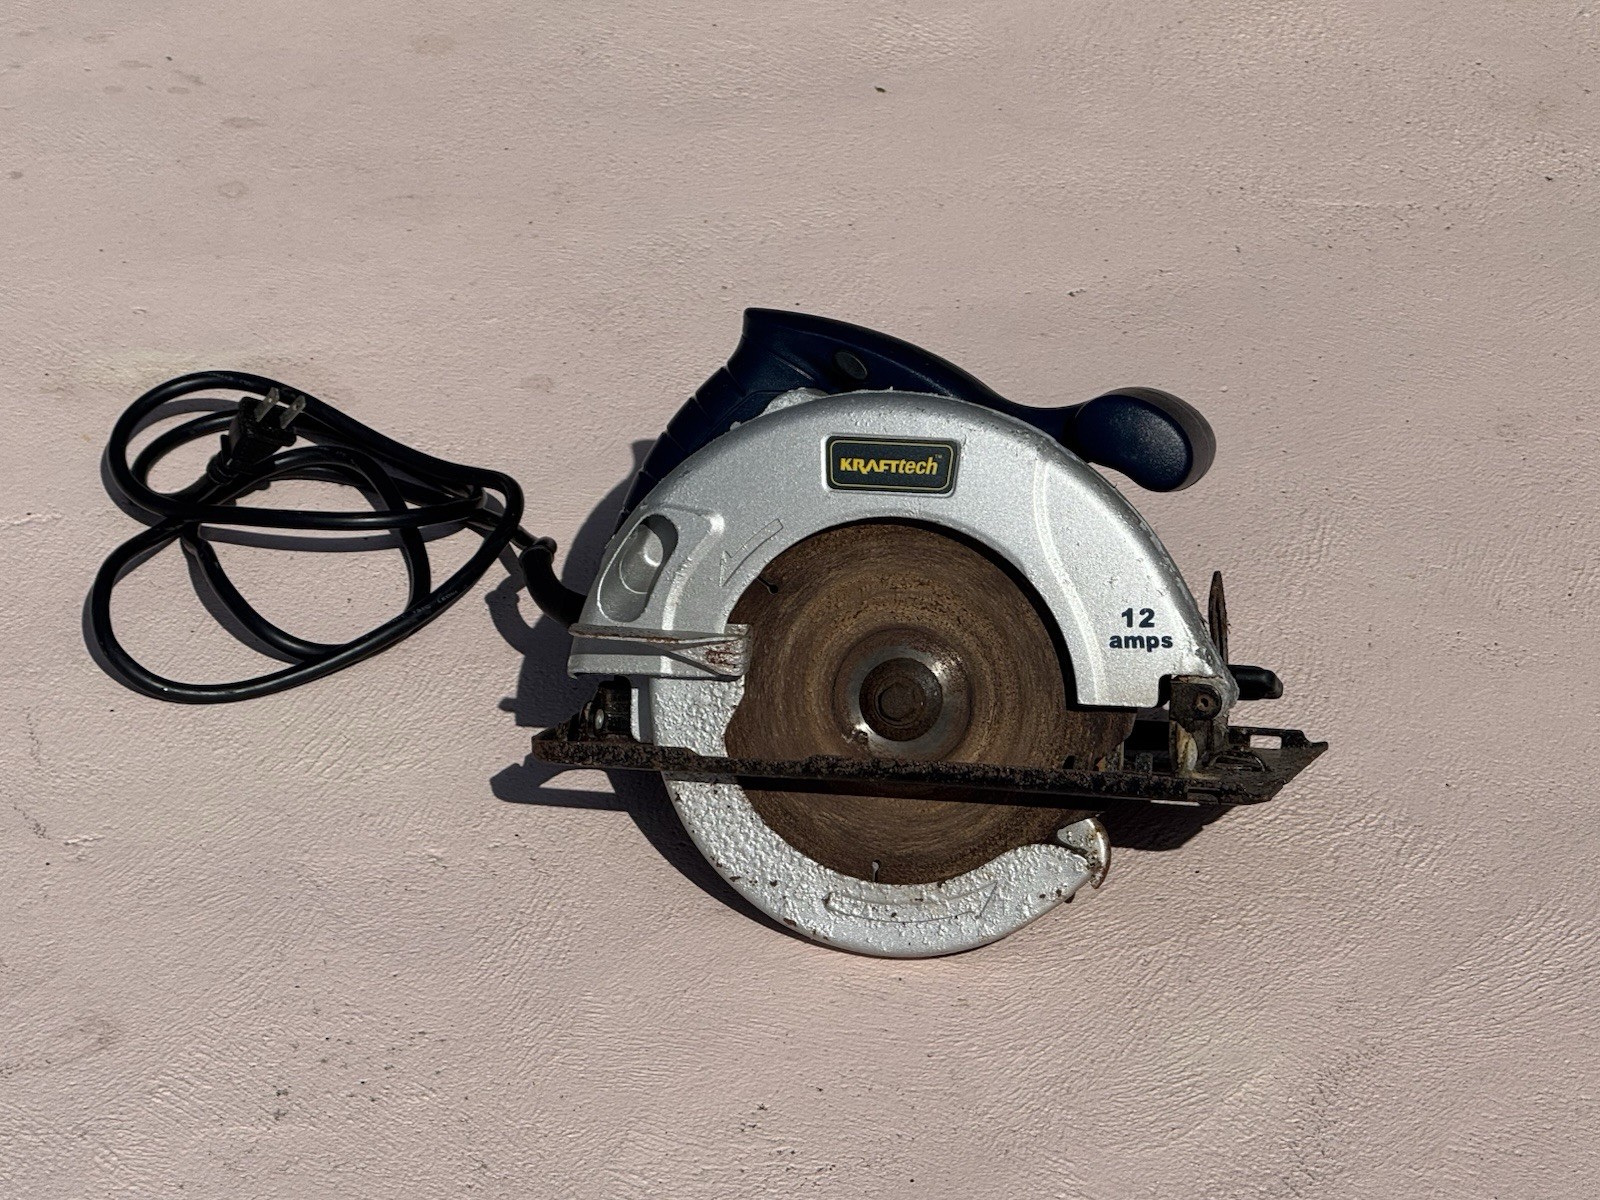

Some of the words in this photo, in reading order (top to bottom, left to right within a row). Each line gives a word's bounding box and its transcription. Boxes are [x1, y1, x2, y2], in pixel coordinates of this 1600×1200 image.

[840, 457, 938, 475] KRAFTtech
[1121, 608, 1155, 628] 12
[1109, 635, 1173, 653] amps
